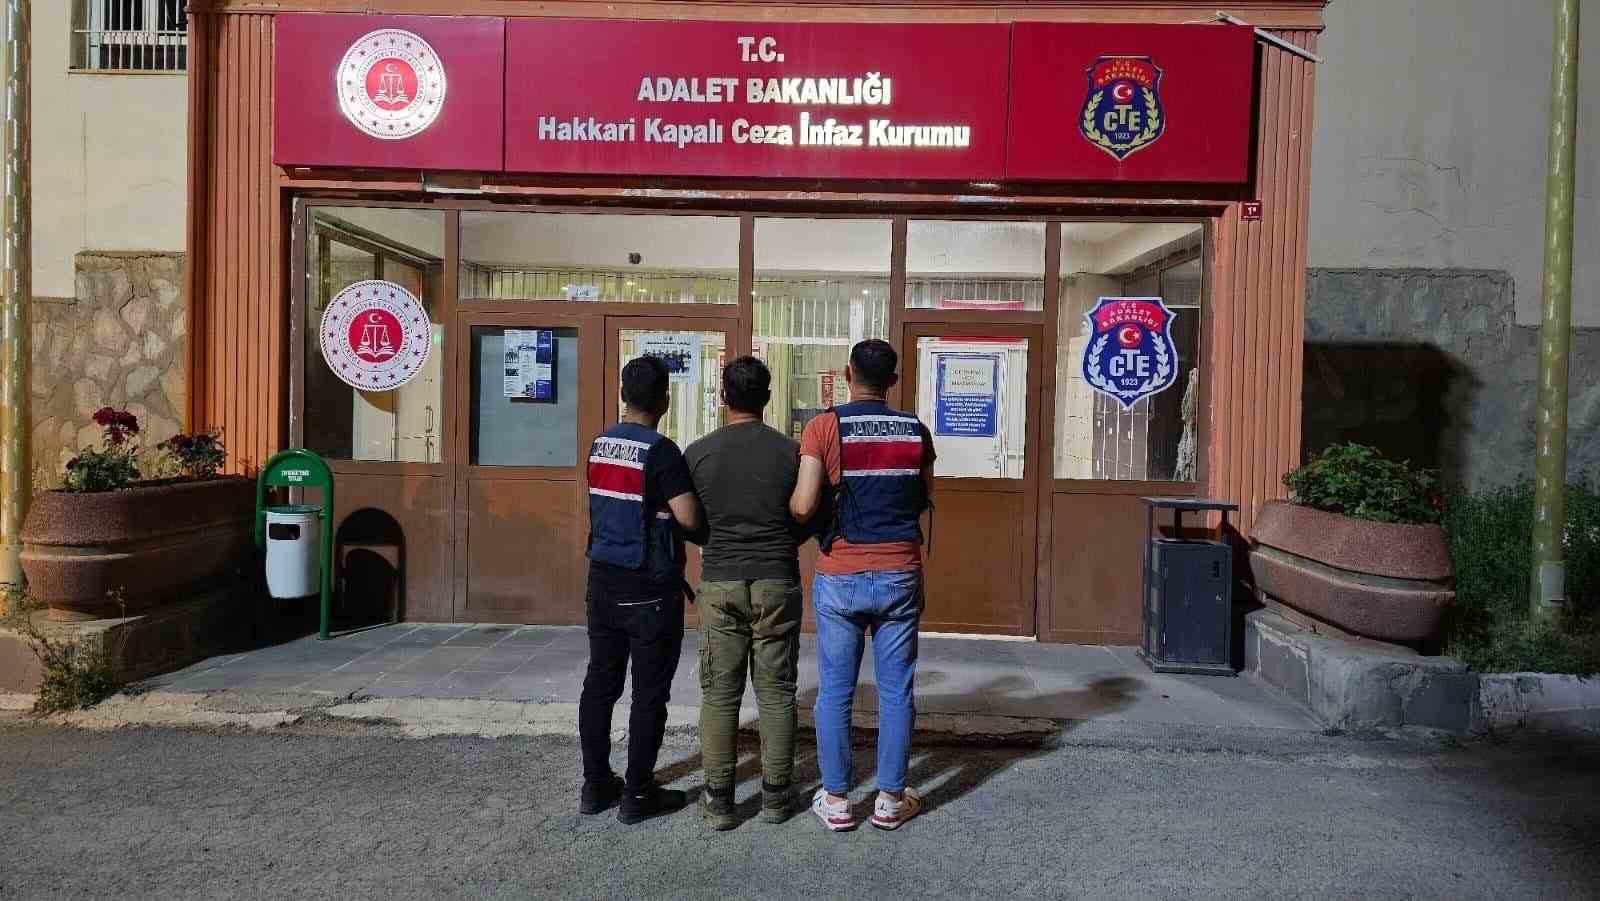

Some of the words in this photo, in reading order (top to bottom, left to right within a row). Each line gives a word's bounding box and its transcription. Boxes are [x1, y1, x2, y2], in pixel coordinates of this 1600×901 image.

[738, 37, 785, 62] T.C.
[637, 77, 739, 102] ADALET
[746, 72, 891, 104] BAKANLIĞI
[538, 117, 635, 142] Hakkari
[644, 118, 723, 149] Kapalı
[731, 118, 793, 145] Ceza
[800, 112, 863, 145] İnfaz
[868, 119, 971, 147] Kurumu
[1104, 104, 1141, 131] CTE
[1109, 348, 1150, 377] CTE
[1121, 378, 1138, 386] 1923
[849, 421, 914, 437] JANDARMA
